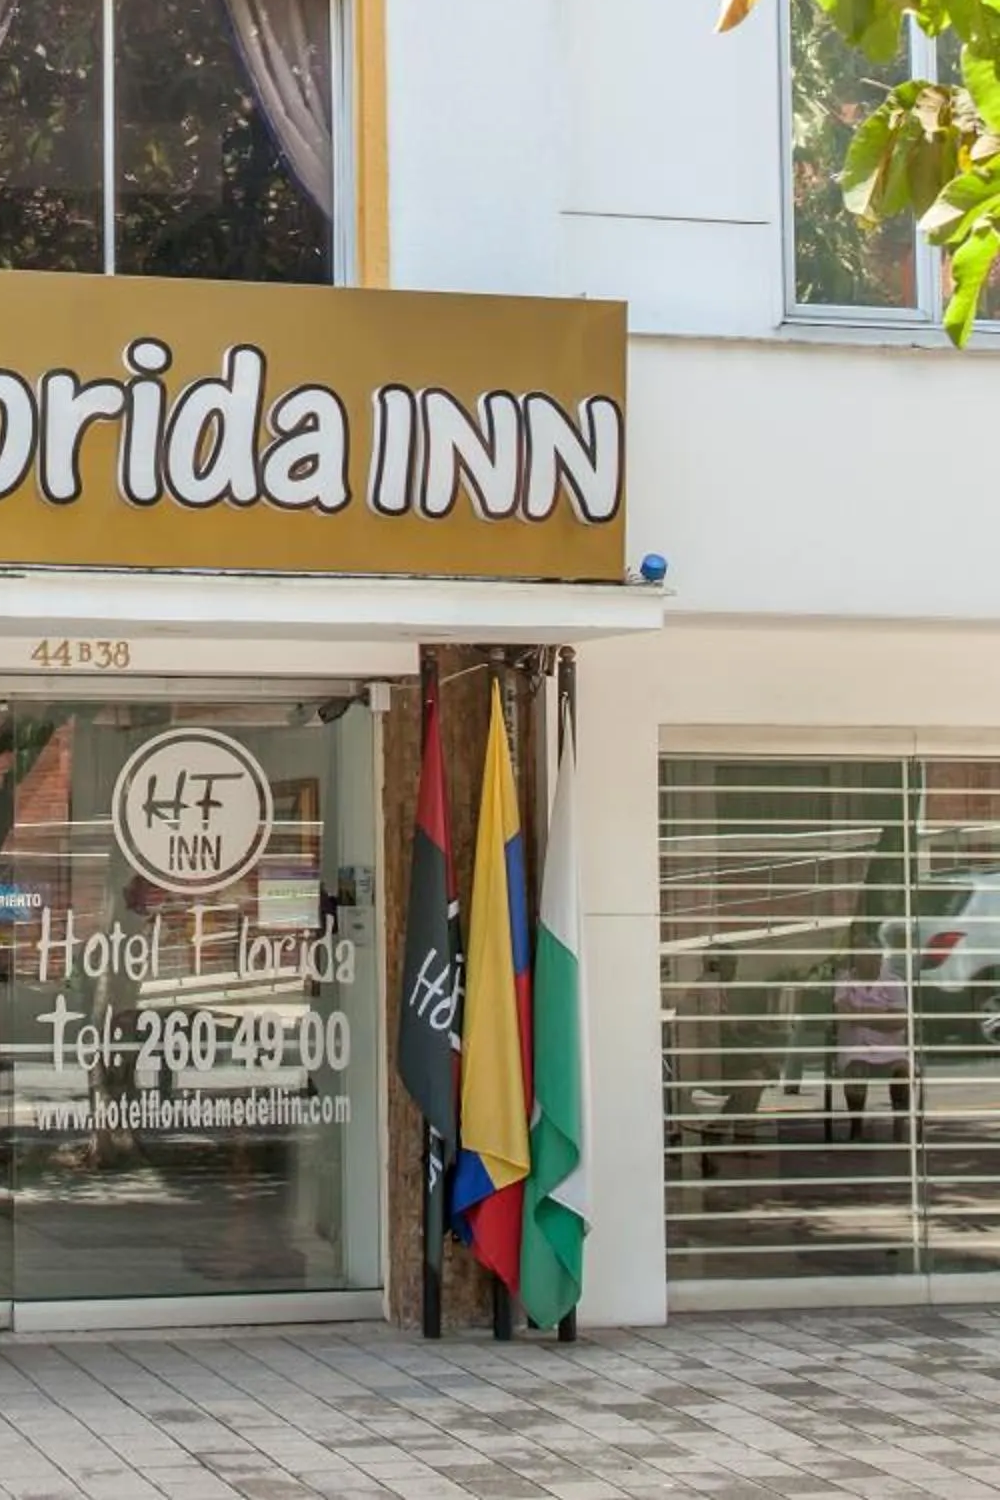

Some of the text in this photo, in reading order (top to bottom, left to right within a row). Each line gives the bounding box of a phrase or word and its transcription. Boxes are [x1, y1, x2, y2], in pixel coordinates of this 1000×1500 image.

[366, 383, 624, 525] INN
[168, 834, 222, 871] INN
[36, 903, 356, 984] Hotel Florida
[136, 1009, 217, 1073] 260
[231, 1009, 285, 1072] 49
[301, 1010, 350, 1072] 00
[36, 1087, 351, 1132] www.hotelfloridamedellin.com
